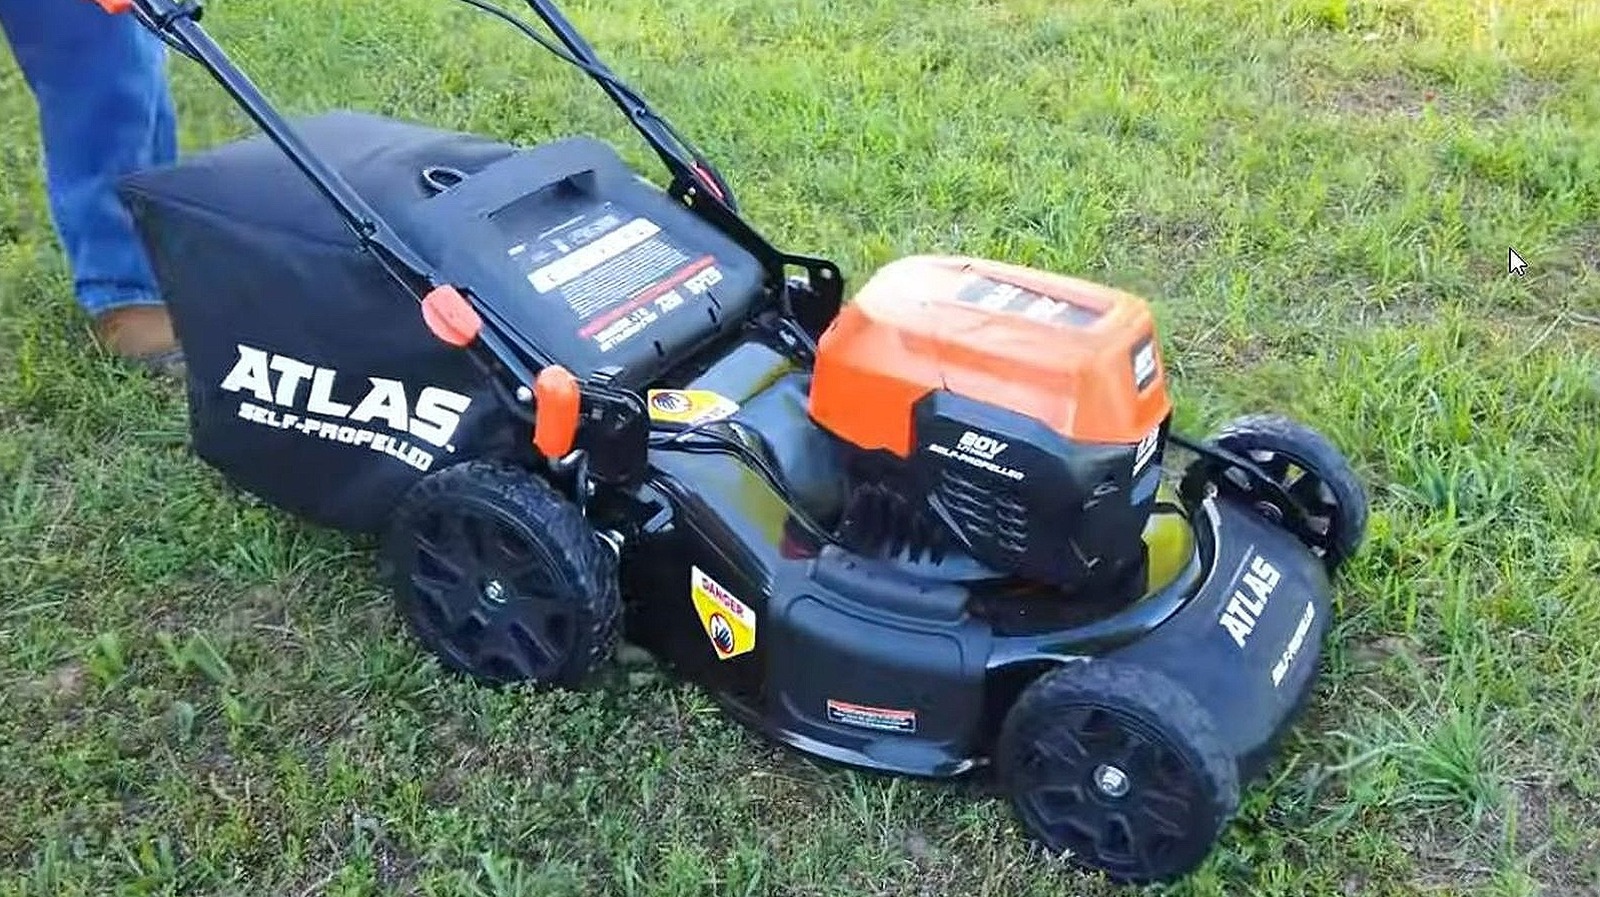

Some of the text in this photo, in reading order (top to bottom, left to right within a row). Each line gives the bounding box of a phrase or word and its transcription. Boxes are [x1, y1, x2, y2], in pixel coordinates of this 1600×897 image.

[221, 344, 472, 448] ATLAS
[238, 402, 434, 472] SELF-PROPELLED
[702, 577, 744, 616] DANGER
[1219, 555, 1281, 648] ATLAS
